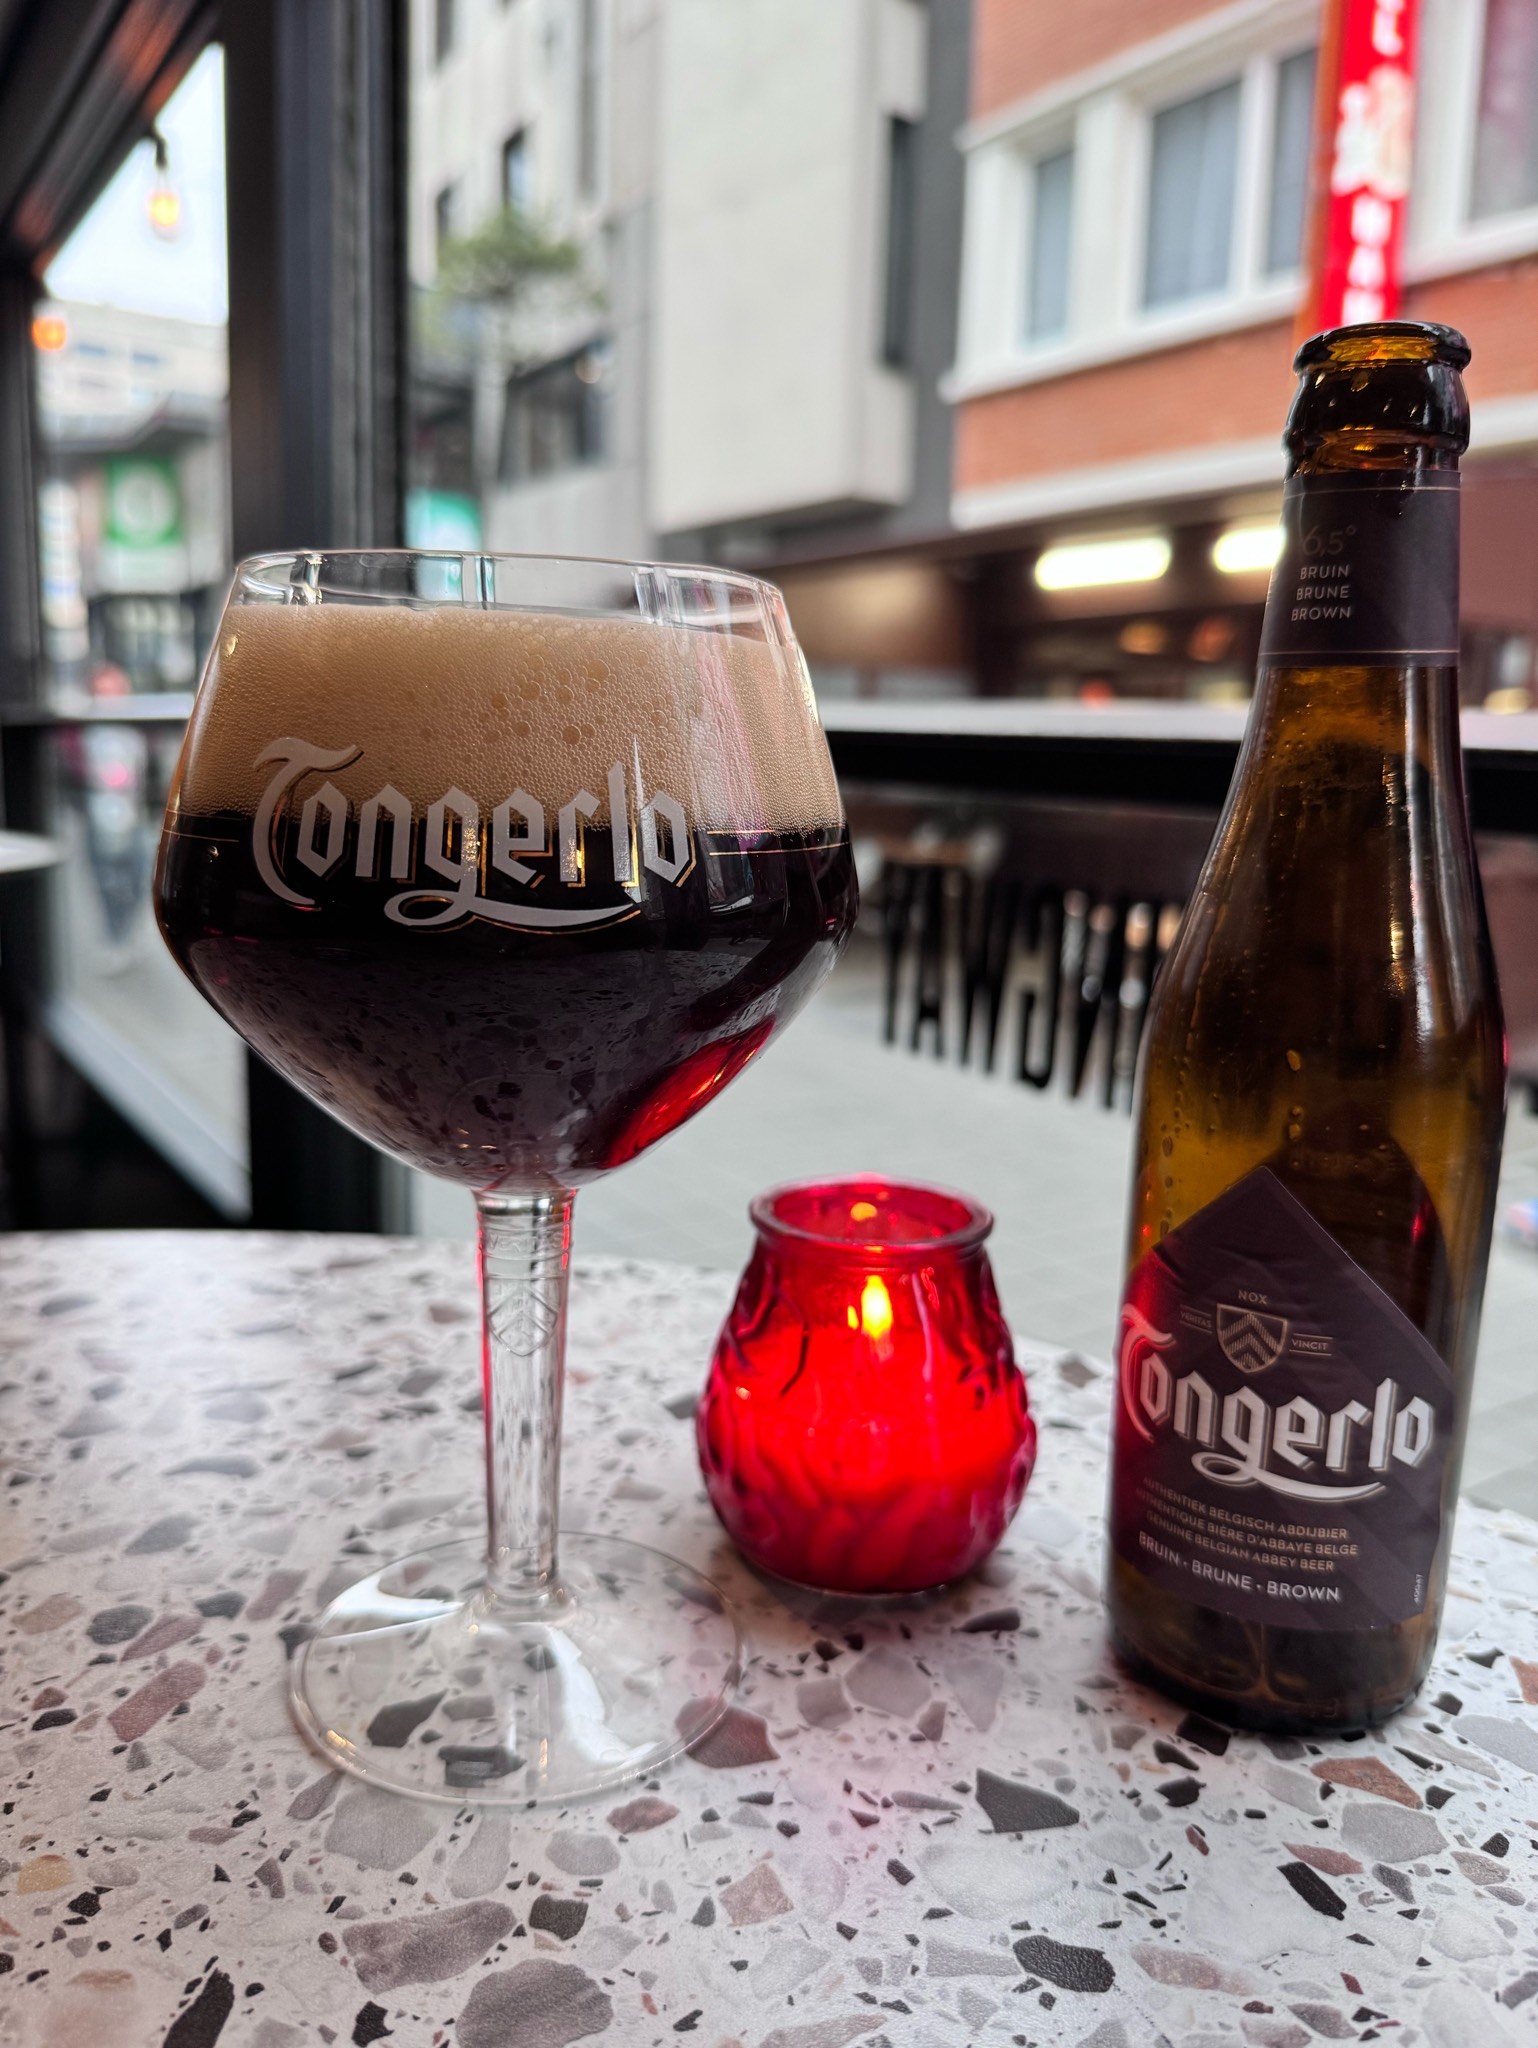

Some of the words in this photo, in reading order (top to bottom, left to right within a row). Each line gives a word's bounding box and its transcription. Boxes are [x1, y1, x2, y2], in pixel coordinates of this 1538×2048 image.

[1295, 584, 1350, 601] BRUNE
[1299, 563, 1351, 581] BRUIN
[1290, 605, 1352, 622] BROWN
[252, 737, 696, 934] Tongerlo
[1237, 1288, 1269, 1305] NOX
[1179, 1310, 1213, 1329] VERITAS
[1291, 1337, 1329, 1351] VINCIT
[1120, 1303, 1435, 1503] Tongerlo
[1142, 1477, 1207, 1514] AUTHENTIEK
[1209, 1506, 1275, 1532] BELGISCH
[1277, 1524, 1349, 1540] ABDIJBIER
[1146, 1510, 1194, 1541] GENUINE
[1194, 1534, 1249, 1560] BELGIAN
[1251, 1551, 1297, 1568] ABBEY
[1299, 1558, 1335, 1572] BEER
[1207, 1520, 1244, 1542] BIÈRE
[1246, 1533, 1312, 1554] D'ABBAYE
[1314, 1543, 1359, 1556] BELGE
[1138, 1530, 1180, 1567] BRUIN
[1191, 1559, 1252, 1590] BRUNE
[1266, 1580, 1340, 1602] BROWN
